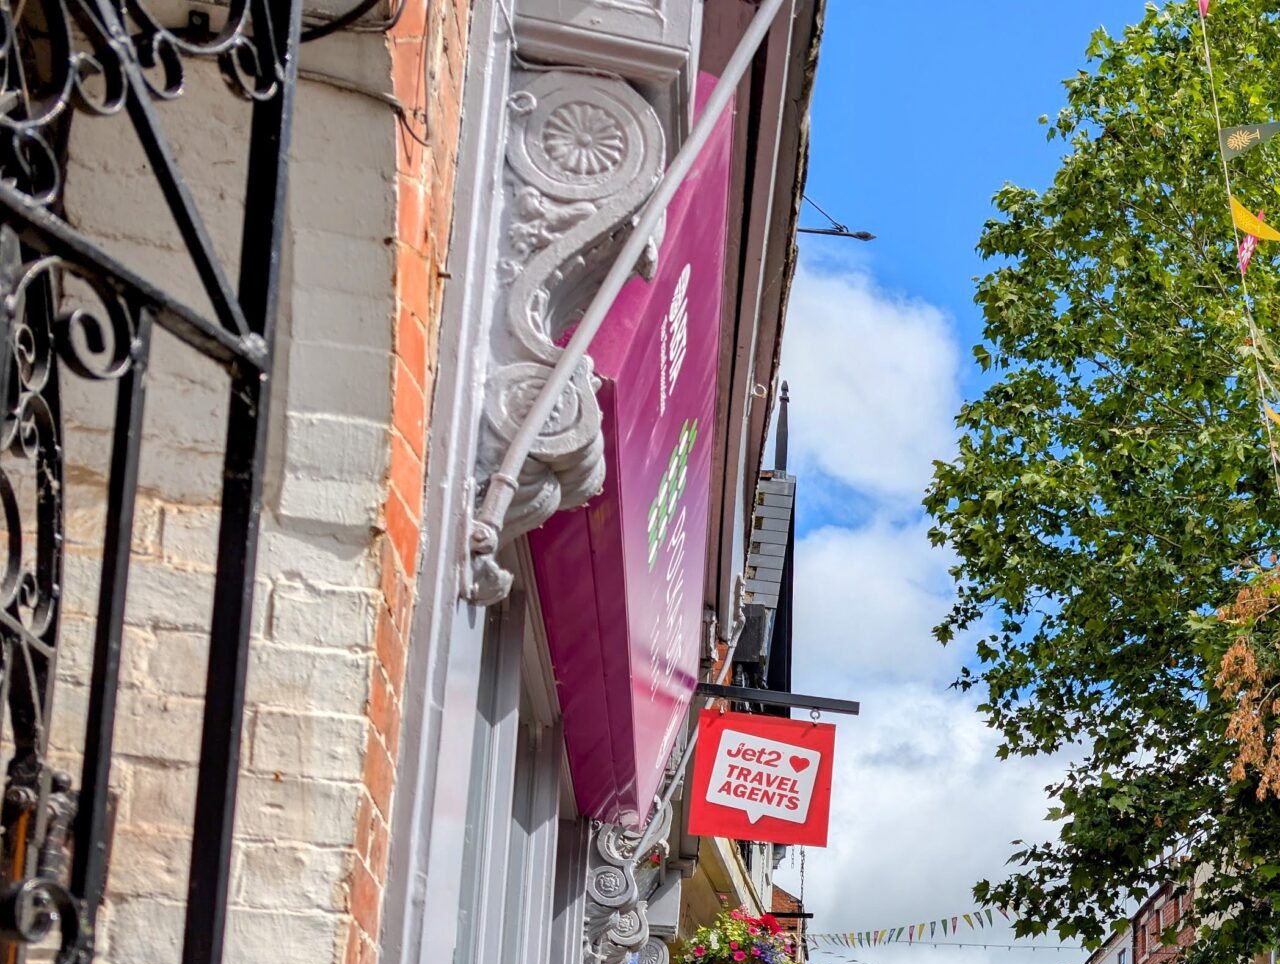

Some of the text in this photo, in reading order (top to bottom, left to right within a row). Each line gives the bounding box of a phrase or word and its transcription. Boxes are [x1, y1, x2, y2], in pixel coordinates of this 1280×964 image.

[669, 296, 688, 398] ABTA
[665, 506, 686, 639] POLKA
[665, 613, 683, 689] DOT
[717, 780, 800, 811] AGENTS
[726, 764, 800, 794] TRAVEL
